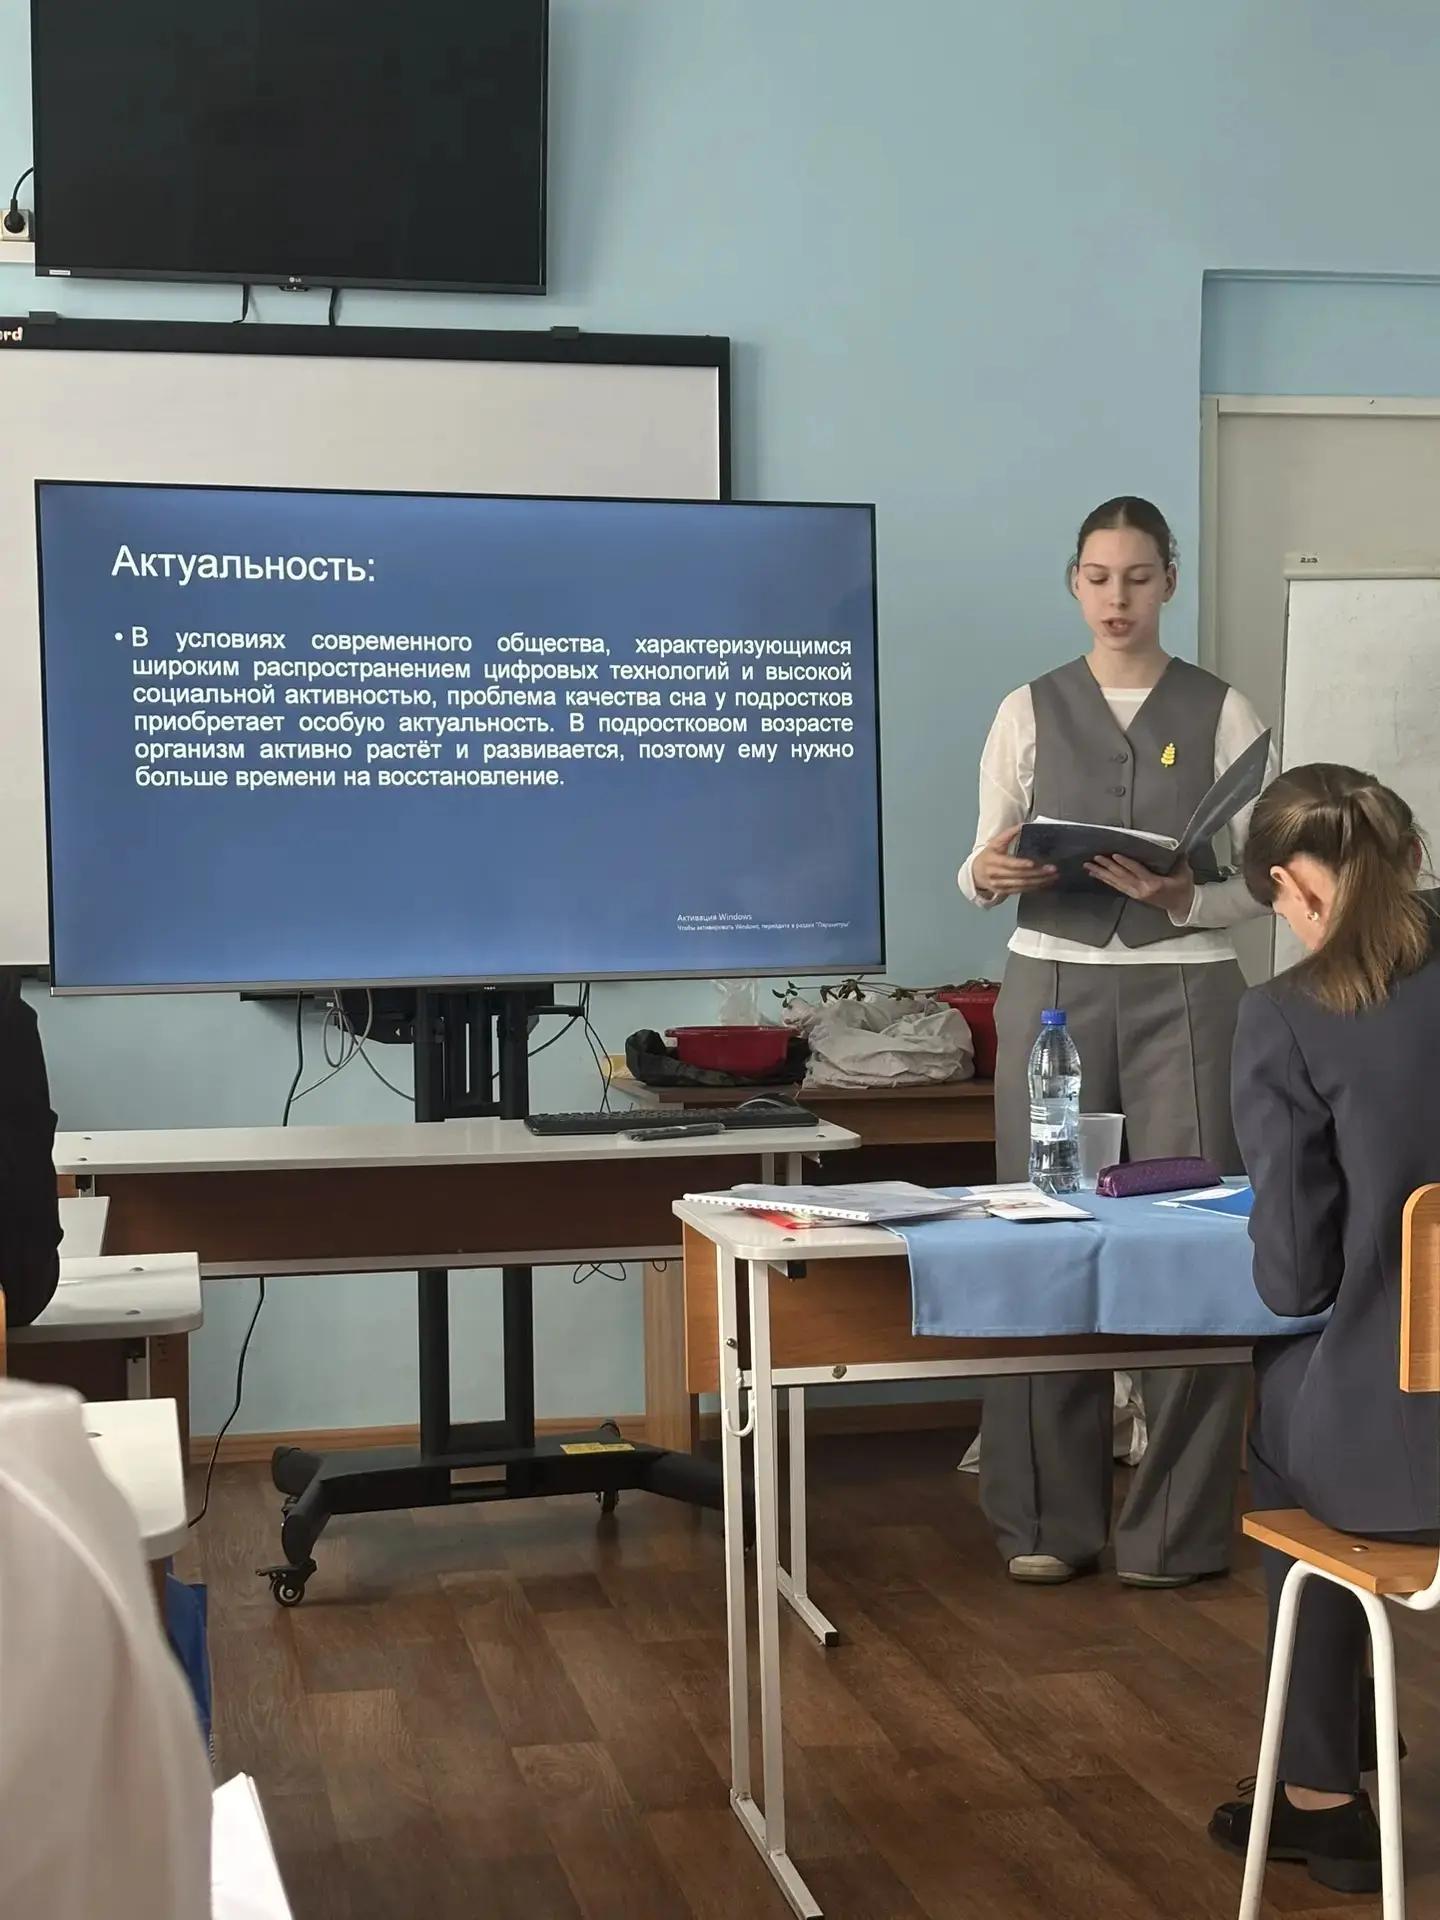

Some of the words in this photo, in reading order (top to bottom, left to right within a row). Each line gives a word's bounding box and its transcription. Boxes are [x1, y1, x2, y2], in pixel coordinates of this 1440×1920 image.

[0, 326, 23, 341] rd
[111, 544, 375, 586] Актуальность:
[131, 626, 149, 647] В
[175, 631, 287, 653] условиях
[311, 634, 473, 656] современного
[496, 631, 611, 657] общества,
[635, 638, 852, 660] характеризующимся
[132, 659, 240, 681] широким
[253, 660, 471, 683] распространением
[484, 658, 599, 684] цифровых
[608, 660, 730, 681] технологий
[741, 665, 754, 681] и
[765, 661, 852, 681] высокой
[132, 683, 275, 707] социальной
[284, 688, 437, 709] активностью,
[447, 684, 557, 710] проблема
[565, 690, 662, 707] качества
[669, 691, 707, 707] сна
[714, 691, 727, 712] у
[734, 691, 854, 711] подростков
[134, 709, 286, 737] приобретает
[298, 710, 385, 737] особую
[398, 716, 555, 738] актуальность.
[569, 712, 585, 733] В
[598, 716, 748, 737] подростковом
[761, 717, 854, 737] возрасте
[134, 742, 245, 764] организм
[259, 742, 353, 759] активно
[366, 739, 443, 764] растёт
[455, 743, 469, 759] и
[483, 743, 625, 764] развивается,
[639, 743, 726, 764] поэтому
[737, 743, 778, 763] ему
[791, 743, 855, 763] нужно
[135, 765, 228, 786] больше
[235, 770, 336, 791] времени
[343, 770, 371, 786] на
[378, 769, 565, 786] восстановление.
[677, 914, 717, 922] Активация
[719, 912, 752, 920] Windows
